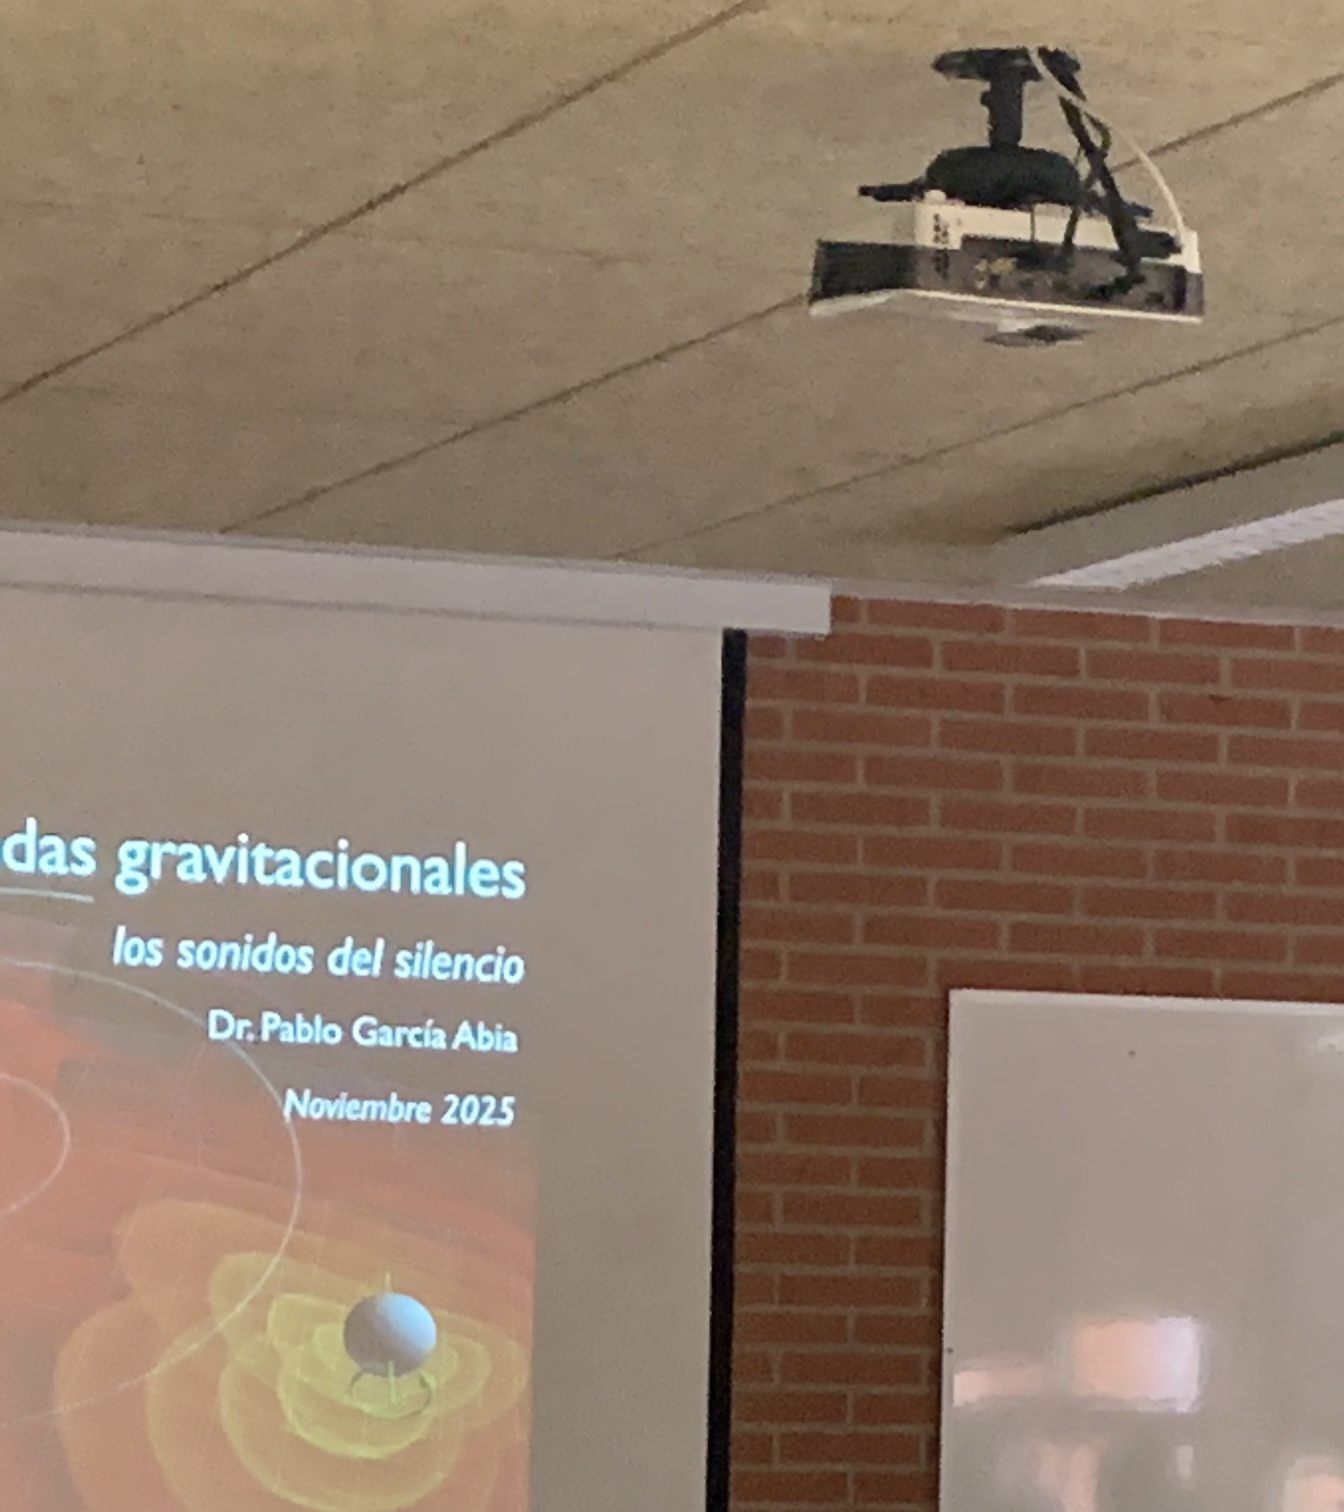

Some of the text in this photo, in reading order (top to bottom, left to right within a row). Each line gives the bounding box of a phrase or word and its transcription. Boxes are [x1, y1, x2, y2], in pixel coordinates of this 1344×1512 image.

[115, 833, 526, 899] gravitacionales
[113, 926, 524, 984] los sonidos del silencio
[208, 1009, 517, 1053] Dr. Pablo García Abia
[283, 1088, 515, 1126] Noviembre 2025
